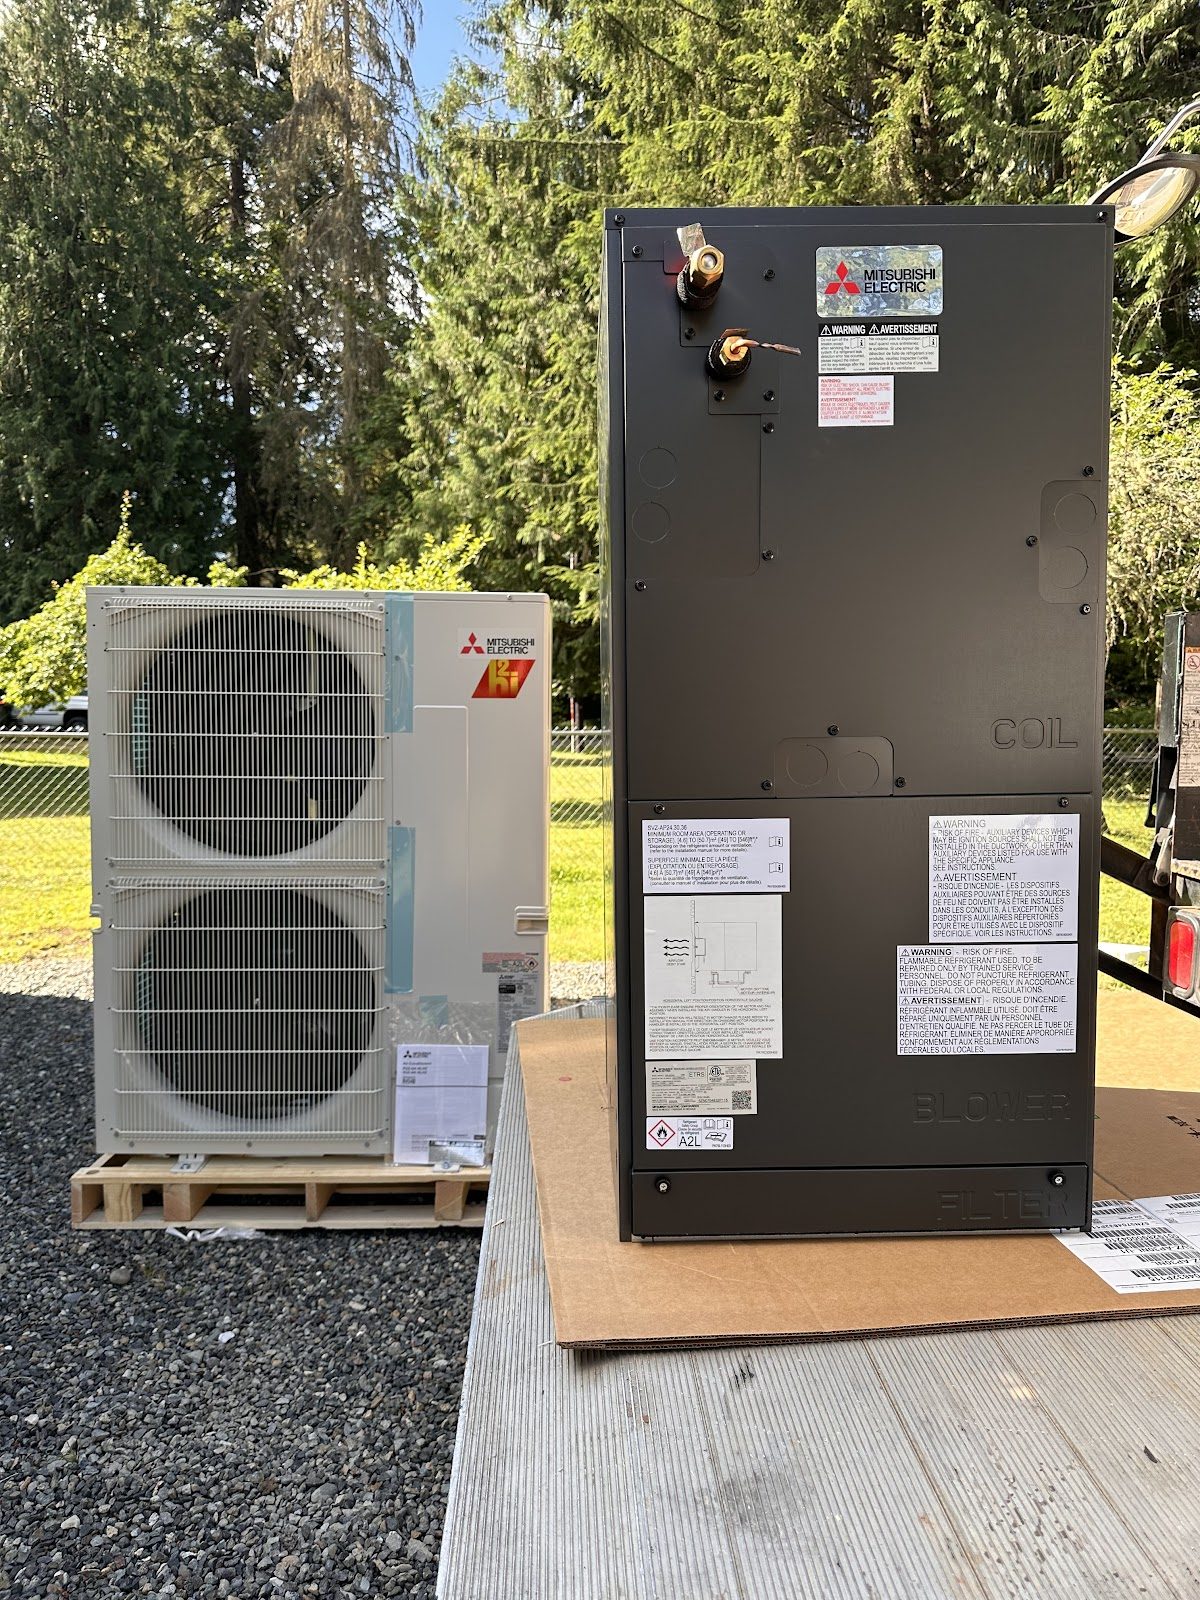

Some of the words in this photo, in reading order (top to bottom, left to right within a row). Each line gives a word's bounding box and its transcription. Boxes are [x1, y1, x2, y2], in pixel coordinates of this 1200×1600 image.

[864, 268, 935, 281] MITSUBISHI
[864, 281, 926, 293] ELECTRIC
[832, 325, 866, 334] WARNING
[880, 324, 937, 334] AVERTISSEMENT
[990, 718, 1078, 750] COIL
[944, 819, 985, 828] WARNING
[944, 872, 1016, 882] AVERTISSEMENT
[911, 1091, 1072, 1124] BLOWER
[679, 1136, 701, 1146] A2L
[936, 1190, 1069, 1220] FILTER
